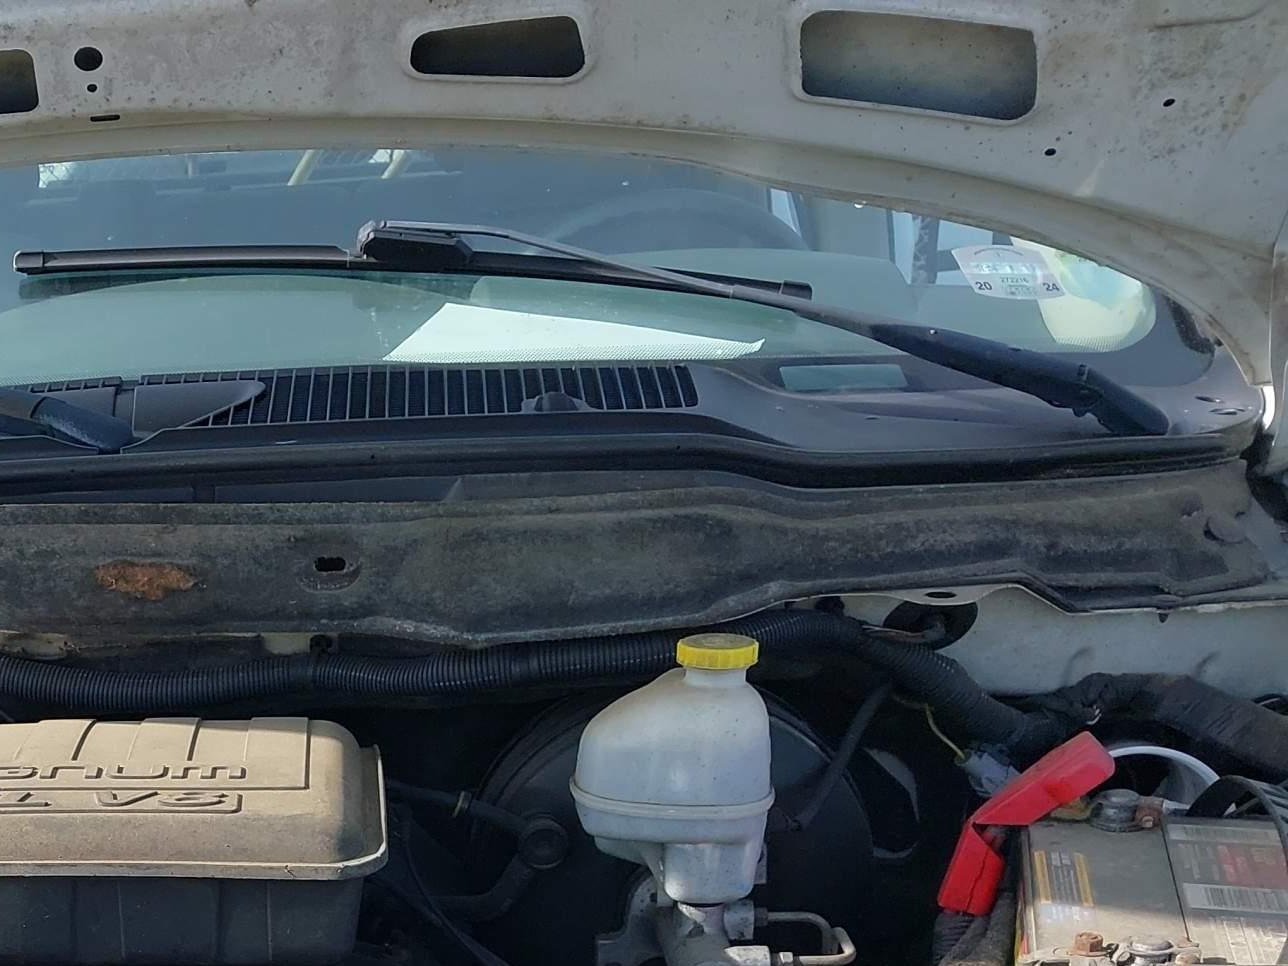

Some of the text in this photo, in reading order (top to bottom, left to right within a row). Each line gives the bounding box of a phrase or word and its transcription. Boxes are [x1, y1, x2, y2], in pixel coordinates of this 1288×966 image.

[975, 281, 993, 291] 20
[1042, 282, 1060, 292] 24
[96, 790, 231, 808] V8
